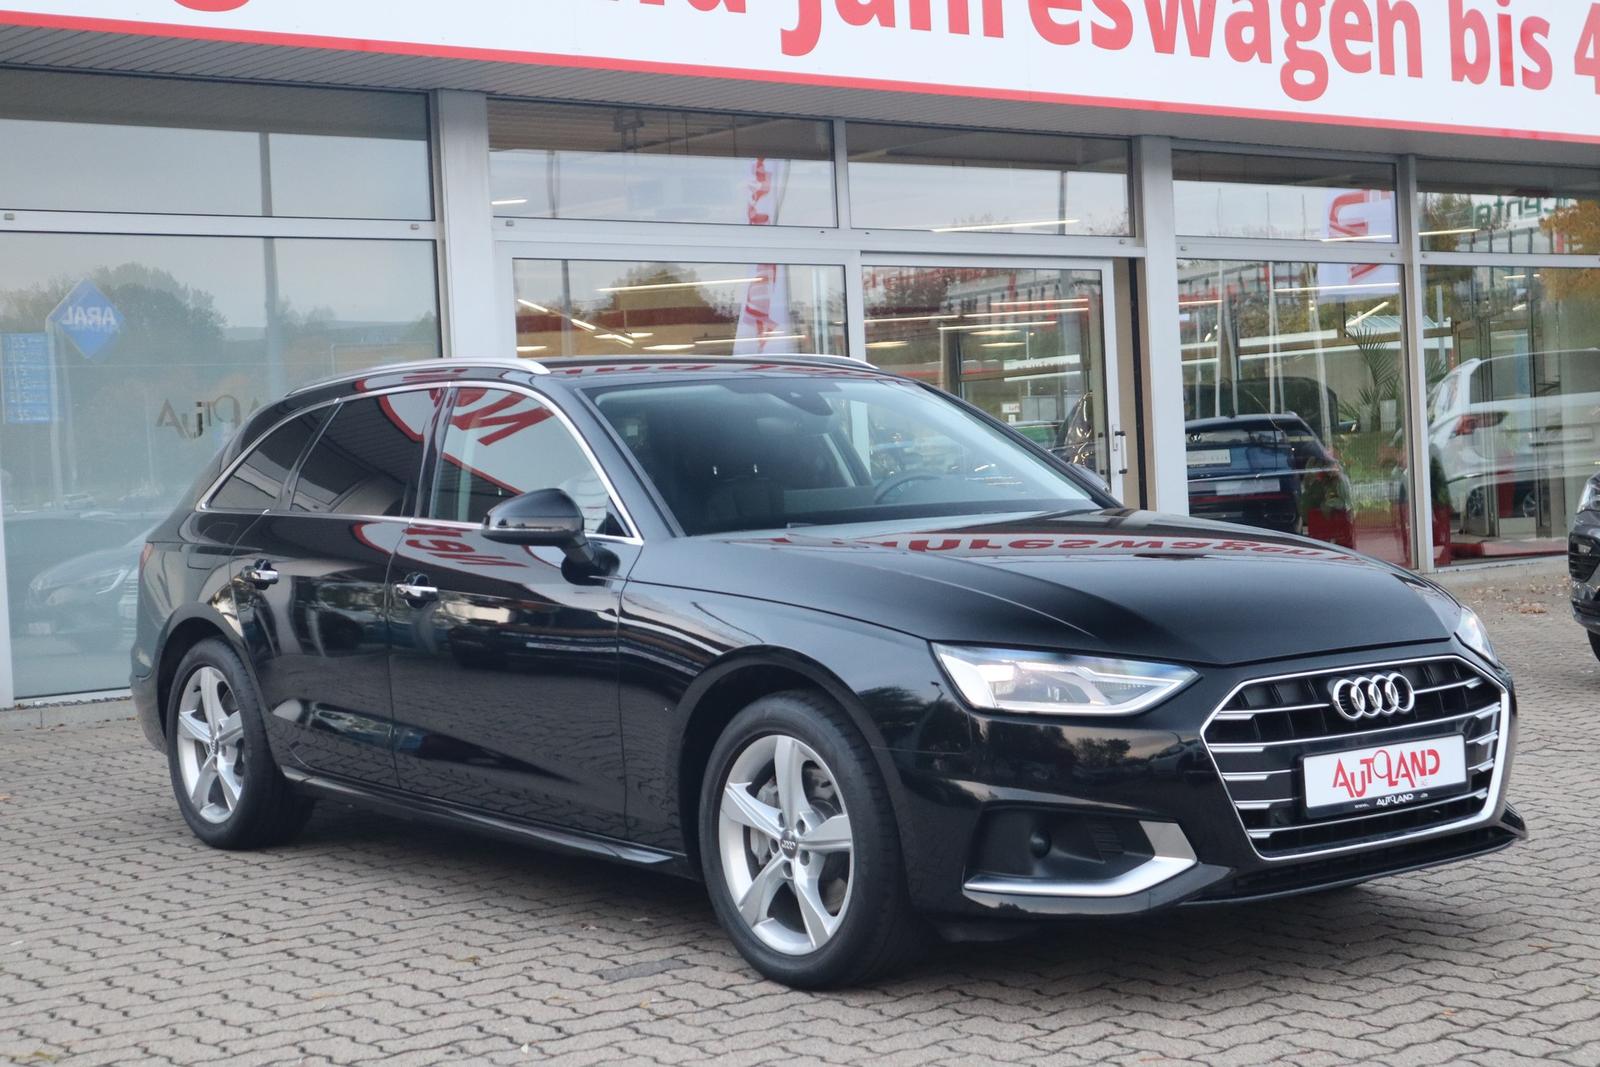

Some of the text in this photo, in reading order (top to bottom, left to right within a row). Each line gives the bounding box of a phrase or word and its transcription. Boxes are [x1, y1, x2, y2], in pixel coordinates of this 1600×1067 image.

[1448, 0, 1553, 90] bis
[1332, 749, 1441, 798] AUTOLAND
[1376, 793, 1414, 806] AUTOLAND
